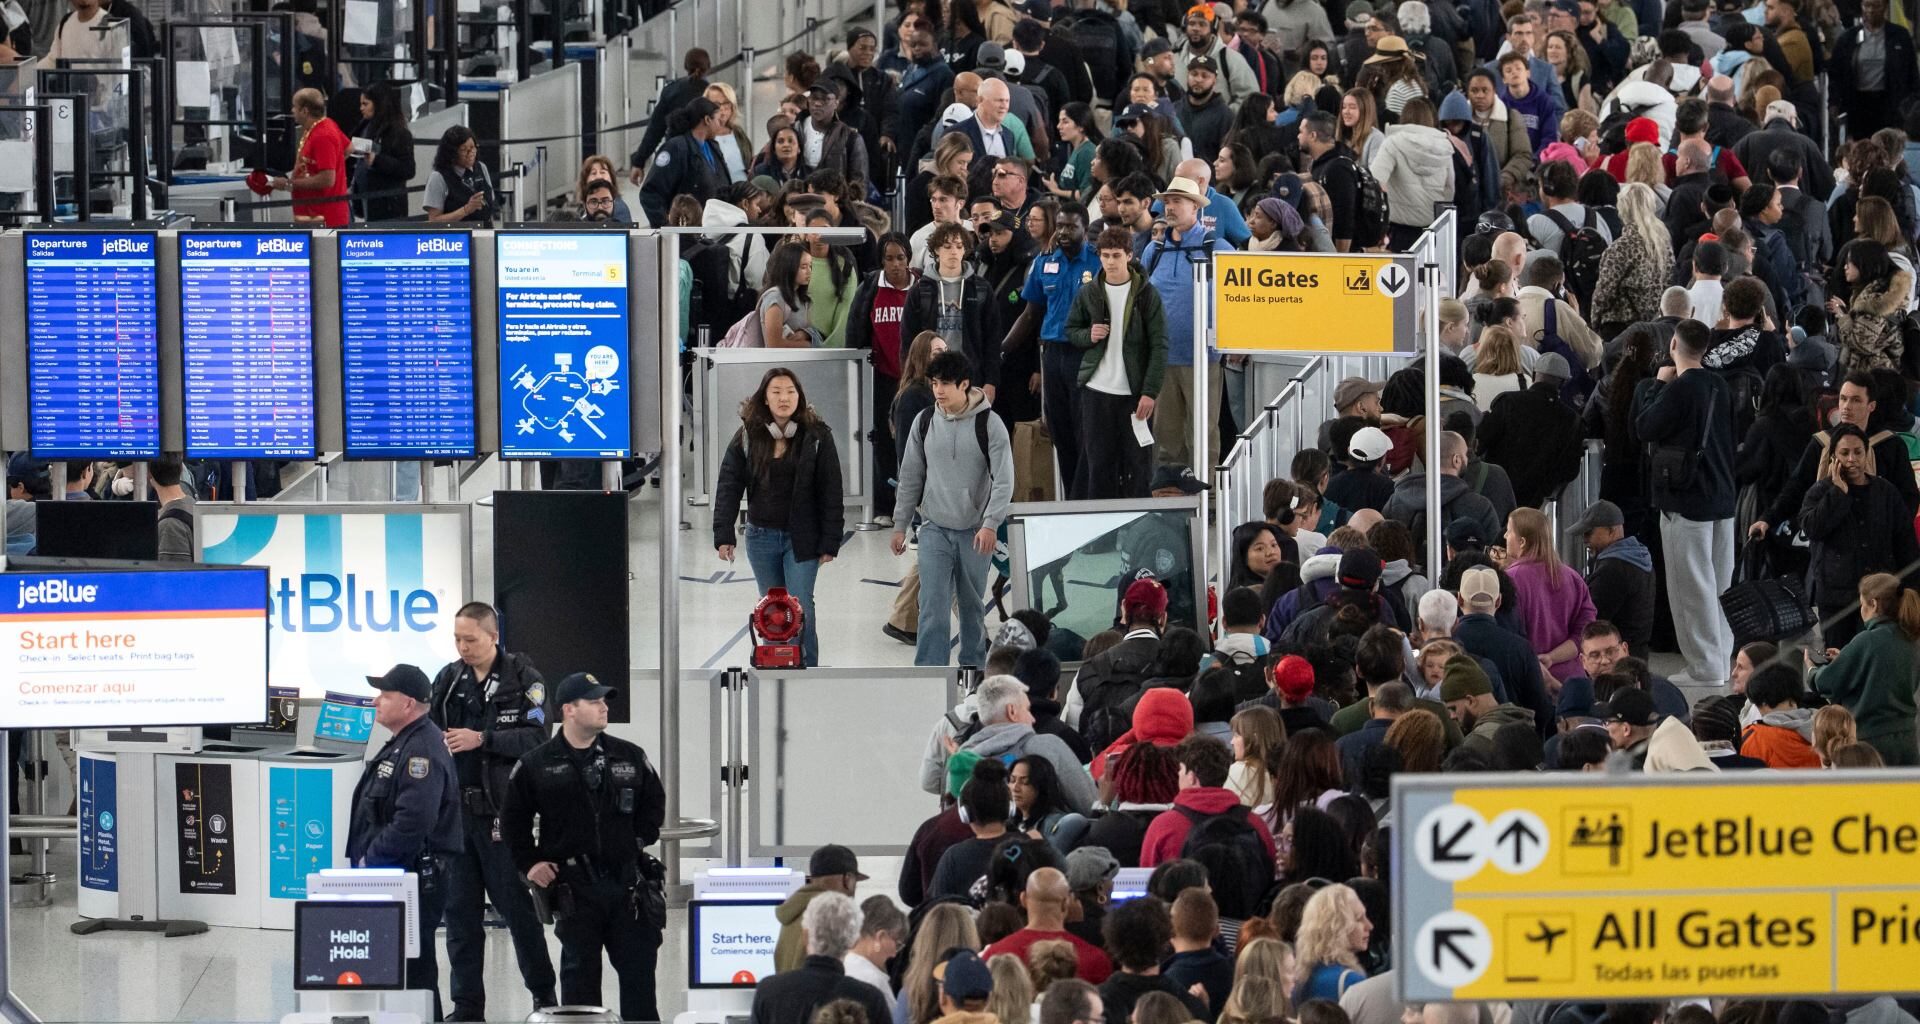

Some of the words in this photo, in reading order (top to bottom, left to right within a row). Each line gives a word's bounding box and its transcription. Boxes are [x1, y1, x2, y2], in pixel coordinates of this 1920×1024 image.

[32, 239, 87, 250] Departures
[102, 239, 149, 255] jetBlue
[186, 239, 242, 250] Departures
[257, 239, 304, 255] jetBlue
[346, 239, 384, 249] Arrivals
[417, 239, 463, 255] jetBlue
[610, 269, 617, 279] 5
[1224, 267, 1252, 287] All
[1257, 268, 1319, 288] Gates
[1224, 294, 1251, 303] Todas
[1253, 294, 1266, 303] las
[1268, 295, 1303, 305] puertas
[17, 580, 98, 609] jetBlue
[271, 574, 439, 632] tBlue
[19, 630, 78, 650] Start
[86, 629, 136, 648] here
[19, 653, 61, 663] Check-in
[67, 652, 97, 662] Select
[98, 653, 124, 661] seats
[130, 652, 152, 660] Print
[154, 651, 172, 662] bag
[174, 651, 195, 661] tags
[19, 681, 97, 695] Comenzar
[1643, 815, 1813, 858] JetBlue
[1592, 909, 1656, 950] All
[1677, 909, 1816, 949] Gates
[1852, 904, 1920, 944] Pri
[330, 930, 370, 943] Hello!
[712, 932, 743, 944] Start
[746, 932, 775, 943] here.
[329, 945, 369, 962] ¡Hola!
[711, 947, 753, 955] Comience
[1594, 963, 1654, 981] Todas
[1661, 963, 1690, 981] las
[1698, 963, 1779, 984] puertas
